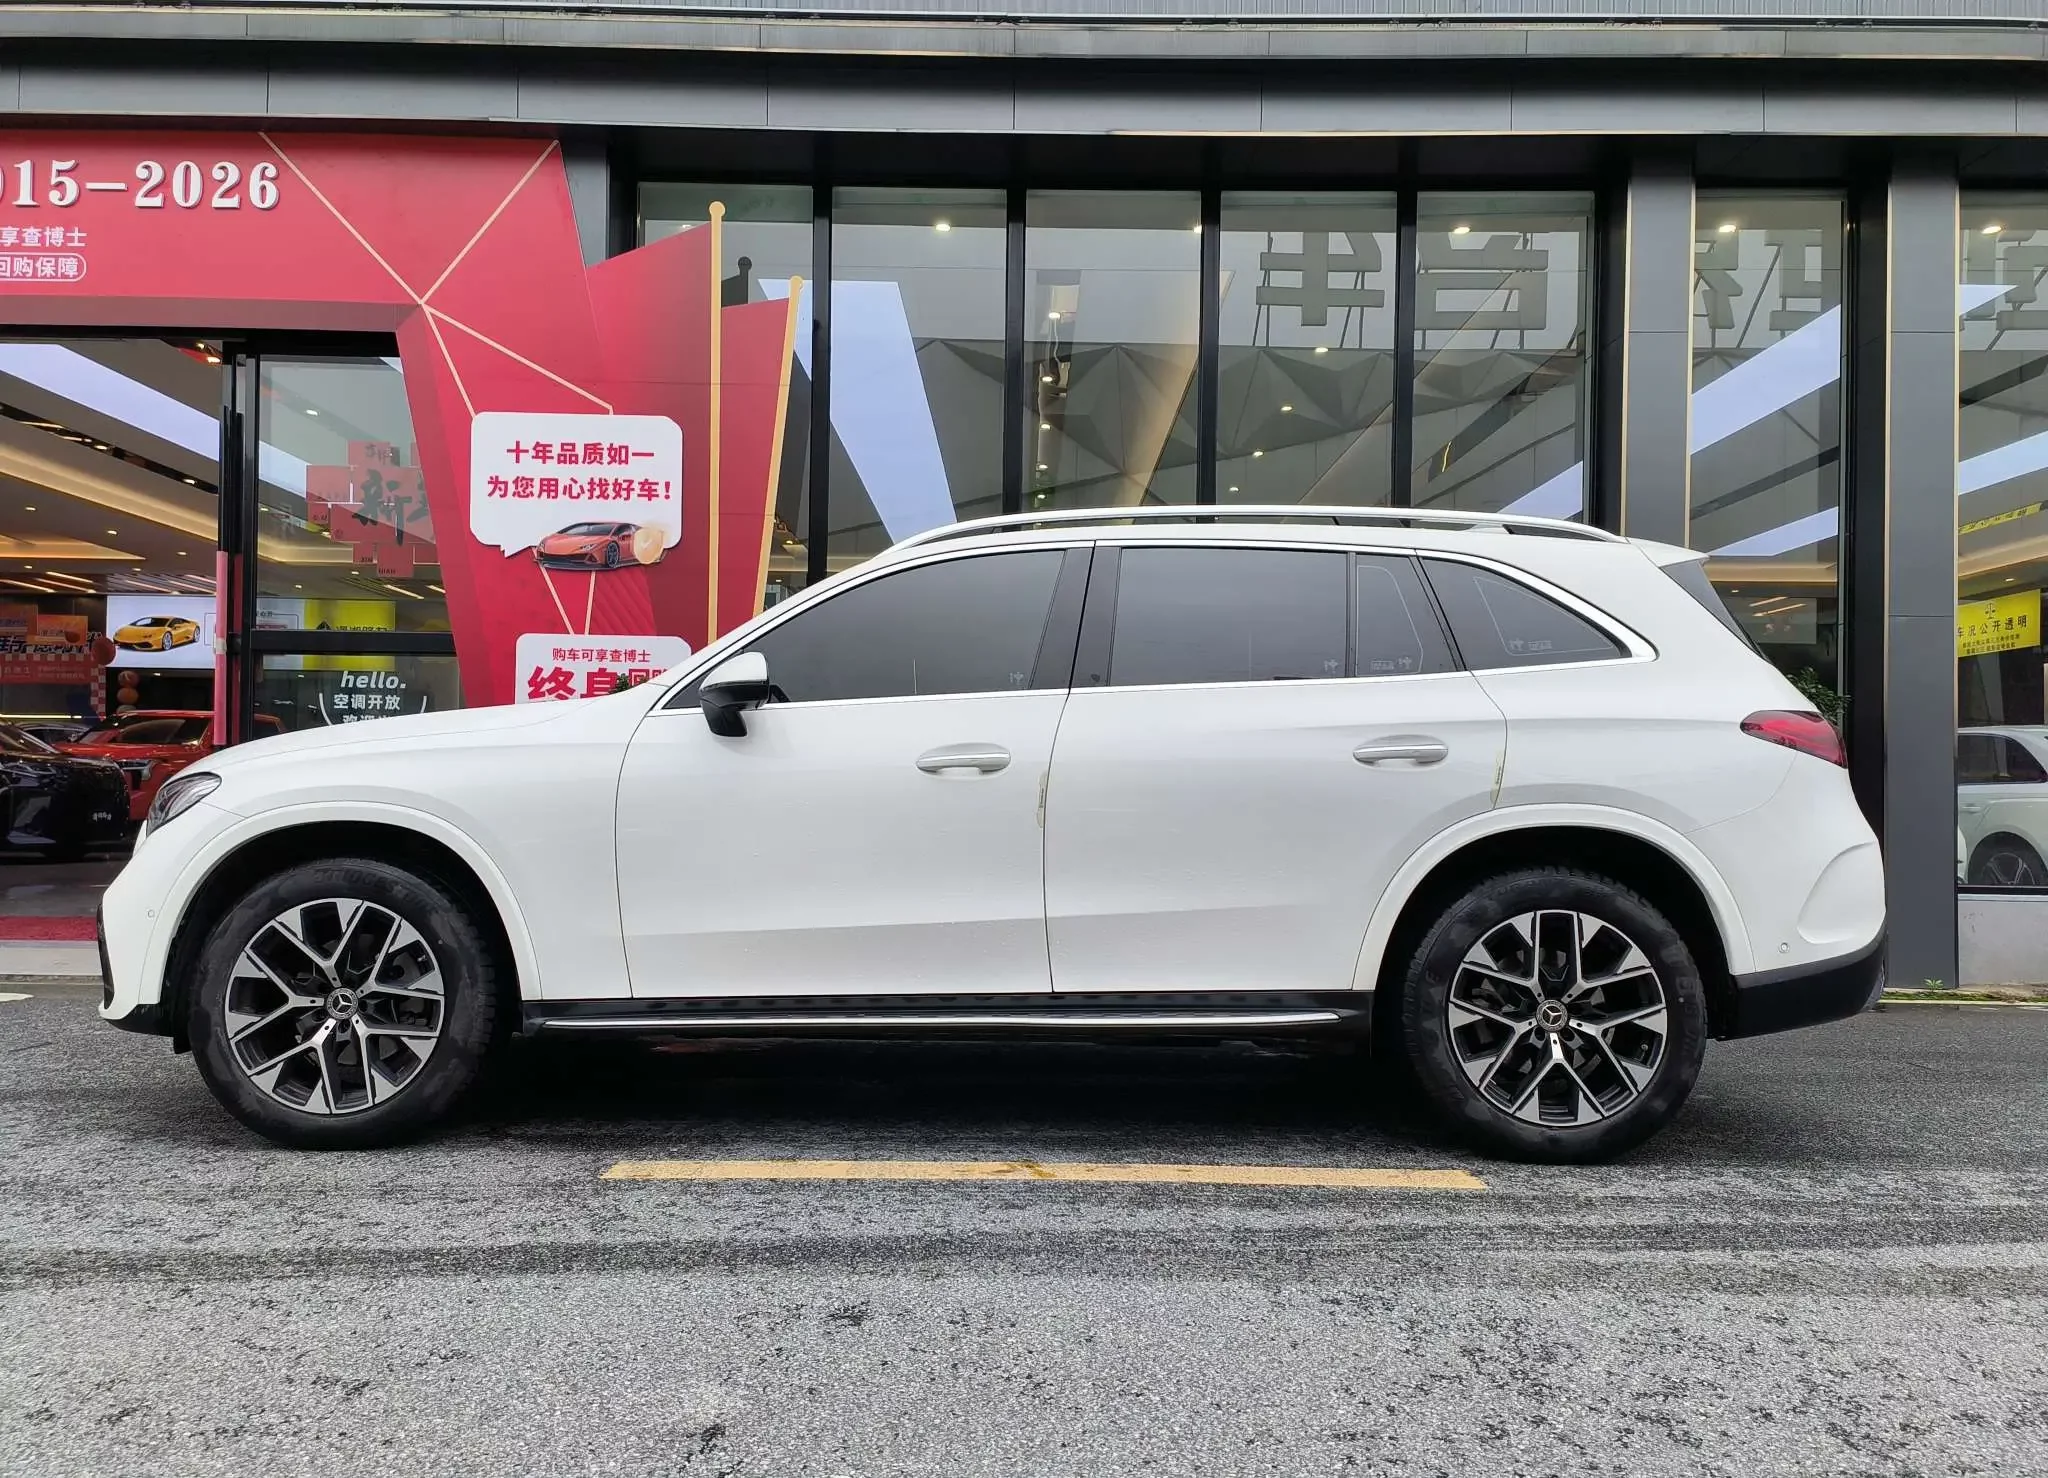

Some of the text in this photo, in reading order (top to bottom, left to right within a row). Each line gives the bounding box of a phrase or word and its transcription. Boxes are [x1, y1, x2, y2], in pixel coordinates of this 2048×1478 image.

[0, 226, 87, 247] 享查博士
[506, 440, 654, 465] 十年品质如一
[487, 475, 671, 501] 为您用心找好车！
[552, 648, 651, 663] 购车可享查博士
[340, 670, 407, 689] hello.
[333, 693, 401, 710] 空调开放
